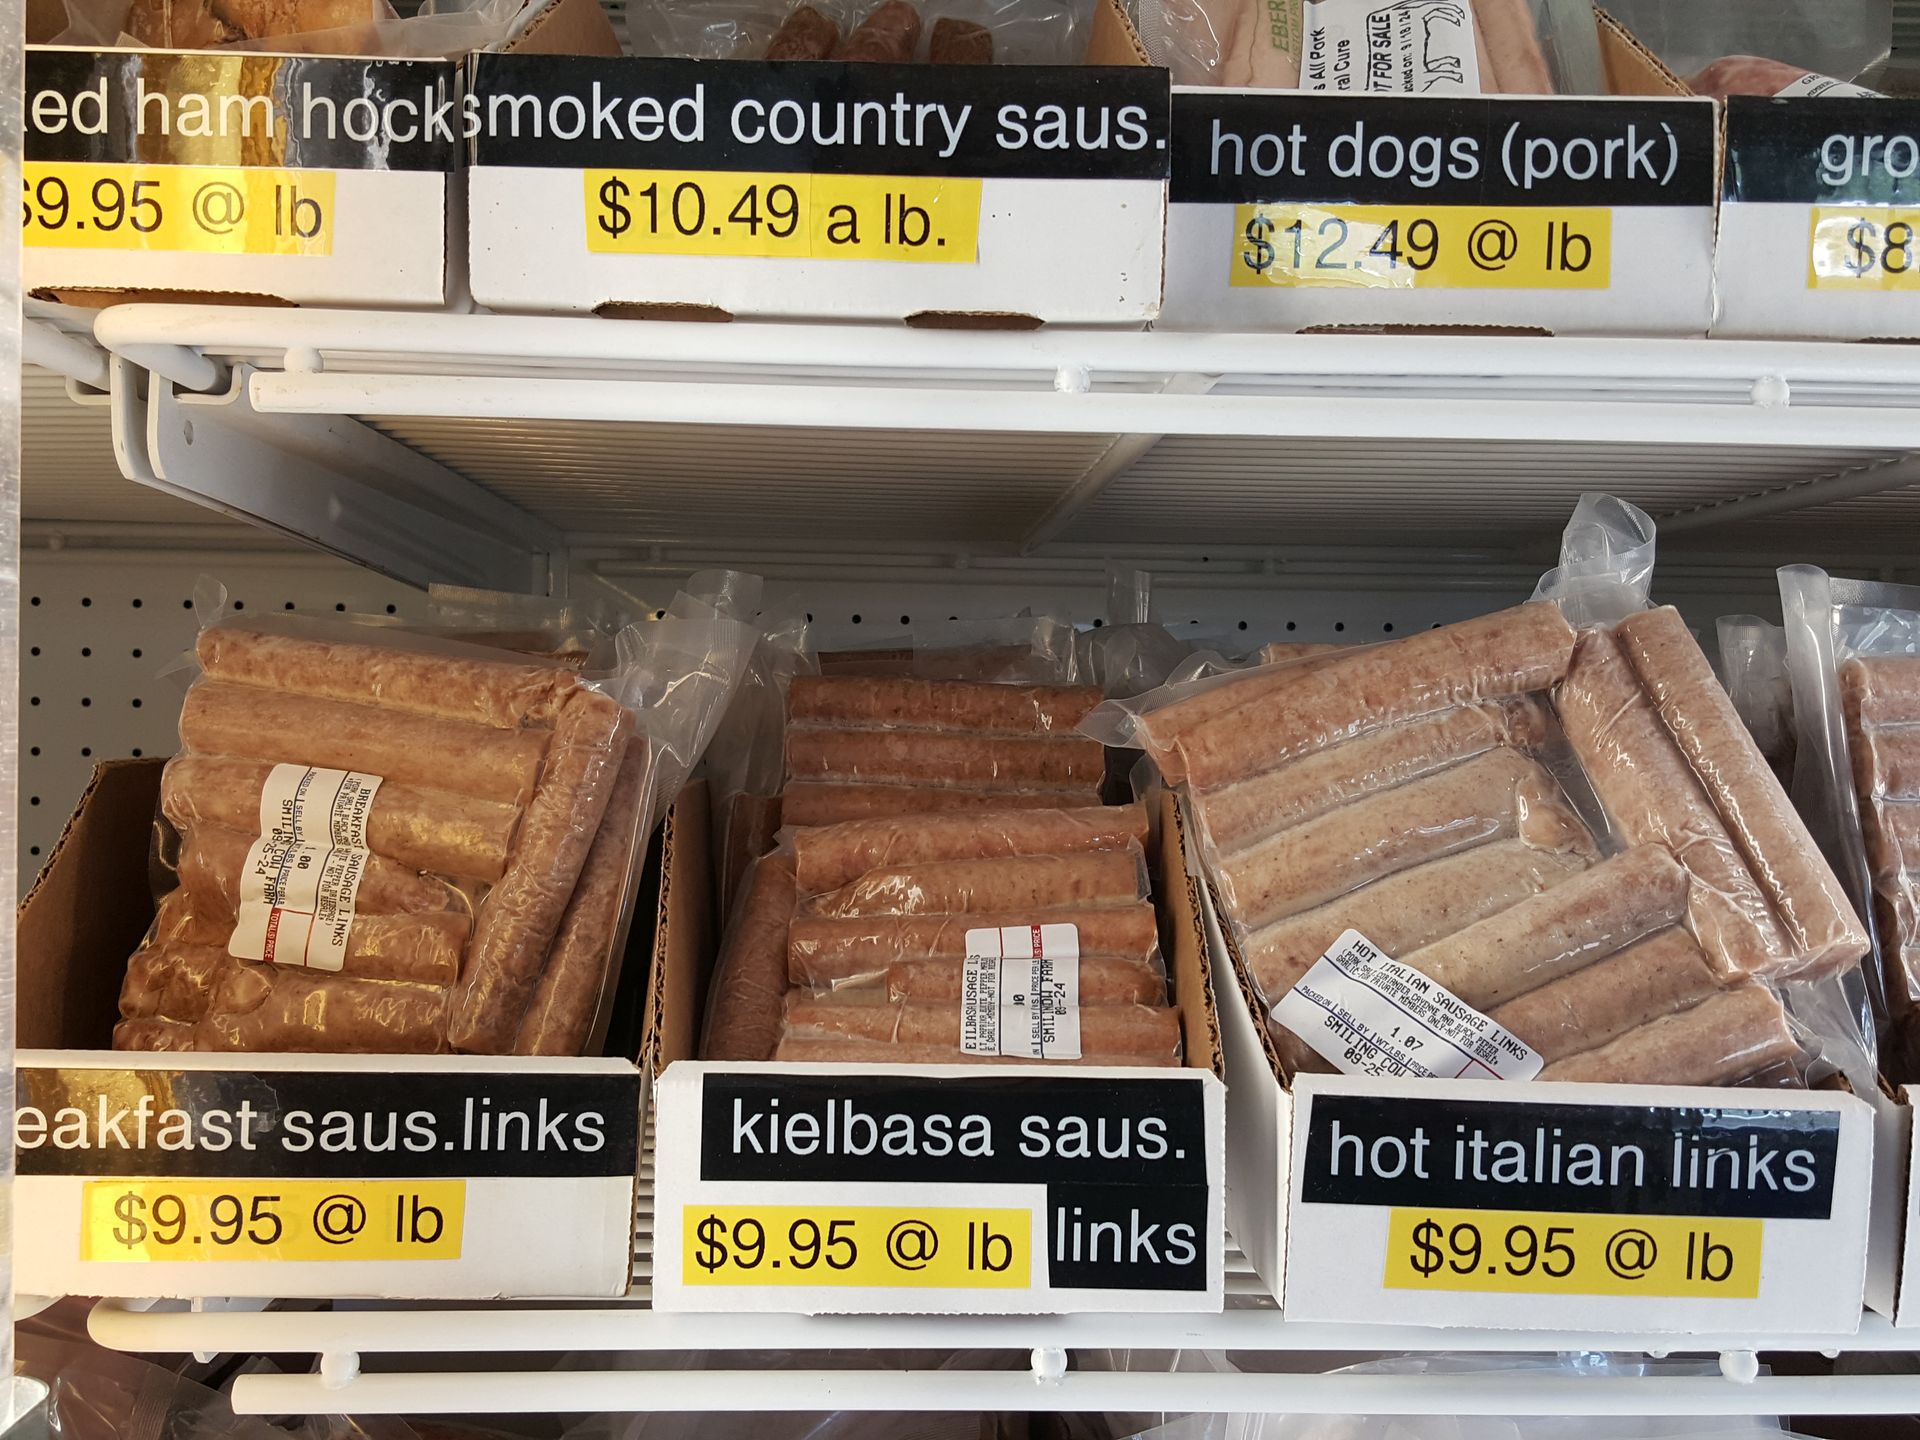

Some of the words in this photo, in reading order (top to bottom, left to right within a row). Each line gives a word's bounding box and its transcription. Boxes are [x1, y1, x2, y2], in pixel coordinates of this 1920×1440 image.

[1309, 26, 1326, 60] Pork
[1371, 13, 1392, 49] SALE
[1333, 39, 1350, 72] Cure
[1372, 51, 1393, 79] FOR
[1372, 80, 1393, 92] T
[22, 76, 109, 135] ed
[136, 78, 274, 139] ham
[462, 82, 704, 143] smoked
[731, 91, 973, 158] country
[995, 103, 1168, 150] saus.
[1210, 119, 1306, 178] hot
[1328, 121, 1479, 189] dogs
[1500, 121, 1679, 189] (pork)
[192, 181, 246, 235] @
[275, 184, 322, 238] lb
[597, 176, 799, 239] $10.49
[826, 204, 861, 245] a
[885, 193, 947, 247] lb.
[1242, 212, 1439, 275] $12.49
[1466, 218, 1519, 271] @
[1545, 221, 1592, 272] lb
[295, 804, 304, 824] SELL
[295, 826, 304, 837] BY
[268, 848, 286, 870] COW
[340, 853, 363, 904] SAUSAGE
[263, 875, 277, 905] FARM
[331, 908, 351, 947] LINKS
[1032, 928, 1041, 948] PRICE
[1031, 1011, 1040, 1020] BY
[1301, 985, 1324, 1004] PACKED
[1321, 998, 1333, 1008] ON
[1351, 940, 1378, 963] HOT
[1379, 962, 1431, 995] ITALIAN
[1432, 991, 1489, 1033] SAUSAGE
[1489, 1029, 1529, 1062] LINKS
[1370, 977, 1399, 999] PRIVATE
[1398, 994, 1428, 1018] MEMBERS
[1459, 1035, 1476, 1050] FOR
[1031, 1022, 1040, 1039] SELL
[1337, 1008, 1357, 1027] SELL
[1356, 1021, 1371, 1035] BY
[1390, 1026, 1424, 1051] 1.07
[1439, 1012, 1455, 1027] AND
[1454, 1023, 1477, 1039] BLACK
[1323, 1015, 1379, 1060] SMILING
[1379, 1057, 1408, 1079] COW
[732, 1098, 995, 1157] kielbasa
[1018, 1114, 1186, 1160] saus.
[1330, 1119, 1430, 1179] hot
[1454, 1124, 1645, 1187] italian
[1671, 1131, 1816, 1192] links
[112, 1190, 283, 1249] $9.95
[312, 1193, 367, 1245] @
[395, 1193, 444, 1245] lb
[1056, 1206, 1197, 1266] links
[694, 1214, 859, 1273] $9.95
[885, 1219, 940, 1271] @
[967, 1221, 1014, 1272] lb
[1409, 1218, 1576, 1279] $9.95
[1605, 1227, 1659, 1281] @
[1686, 1231, 1734, 1283] lb
